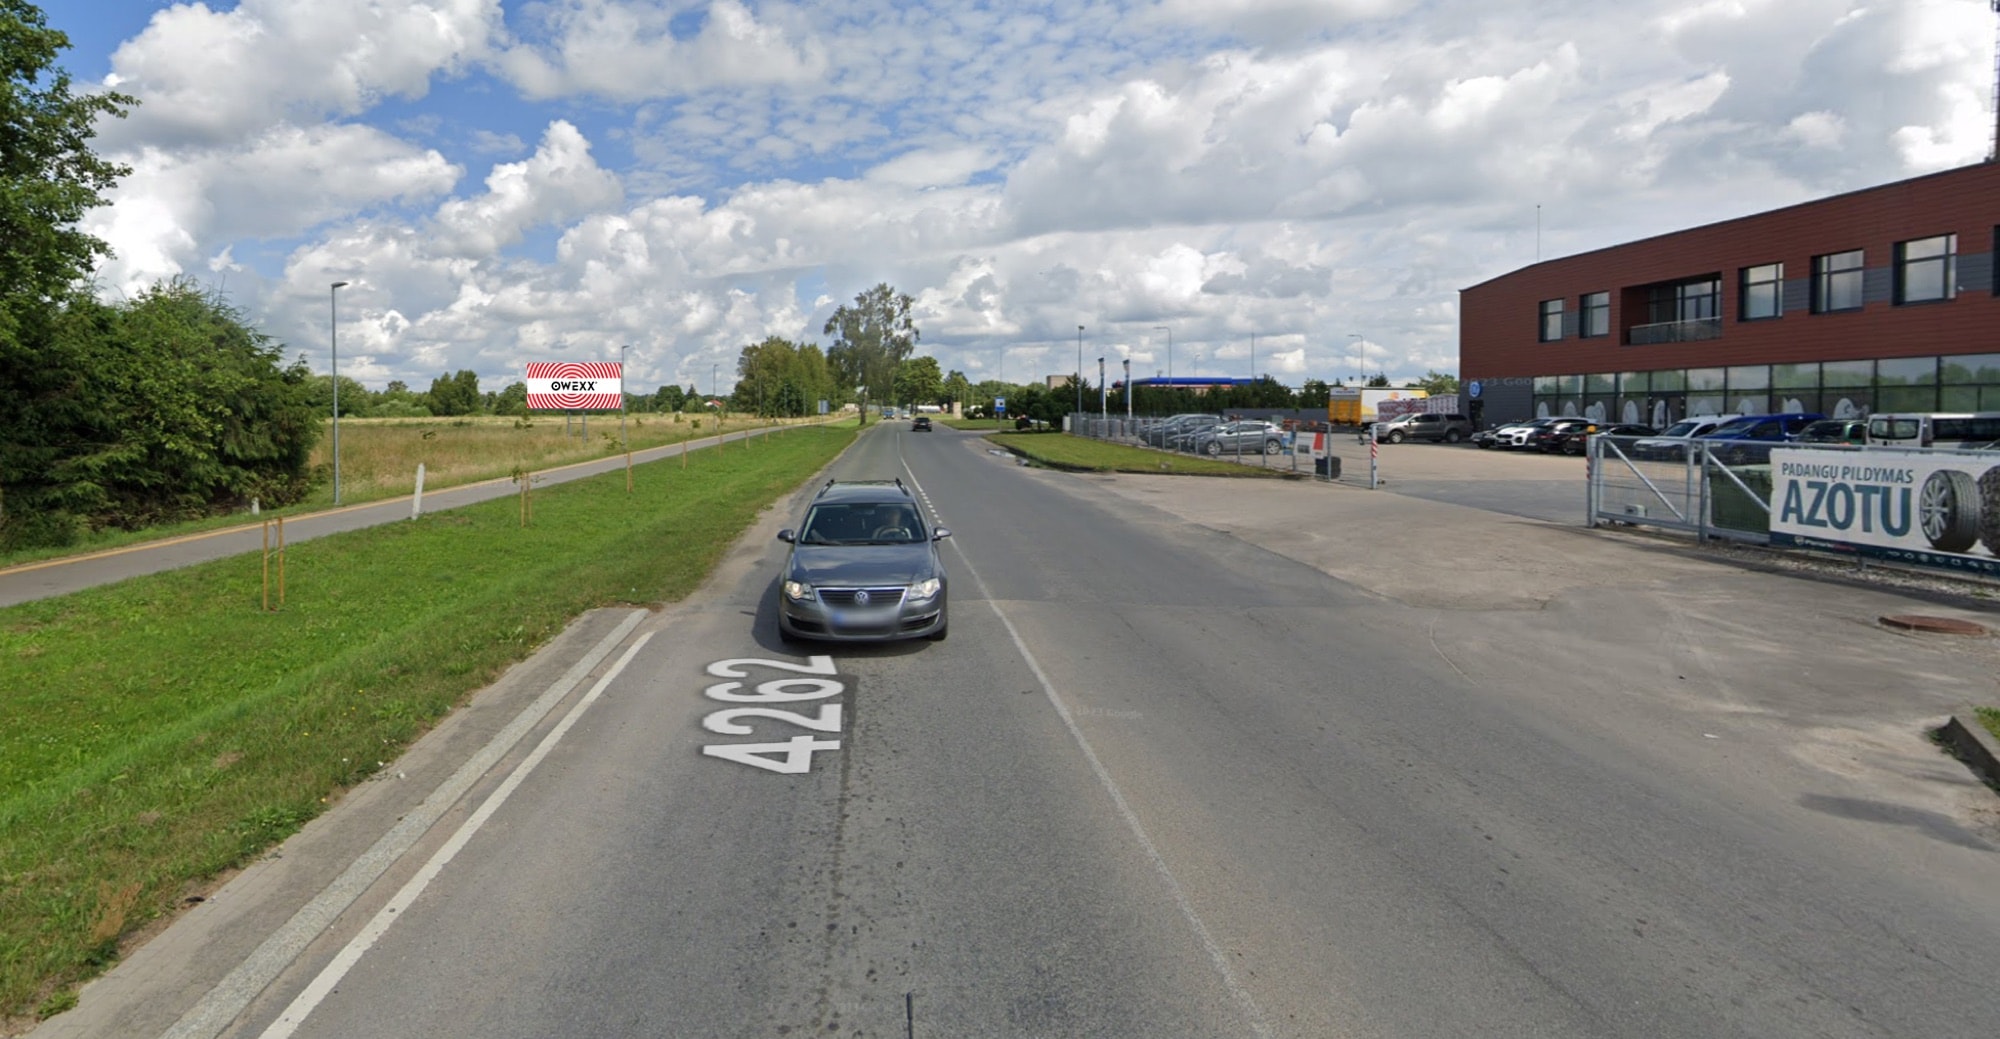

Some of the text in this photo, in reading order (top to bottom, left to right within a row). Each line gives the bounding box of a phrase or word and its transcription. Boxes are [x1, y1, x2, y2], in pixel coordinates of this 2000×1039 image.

[551, 381, 595, 391] OWEXX
[1781, 462, 1914, 484] PADANGŲ PILDYMAS
[1781, 479, 1911, 537] AZOTU
